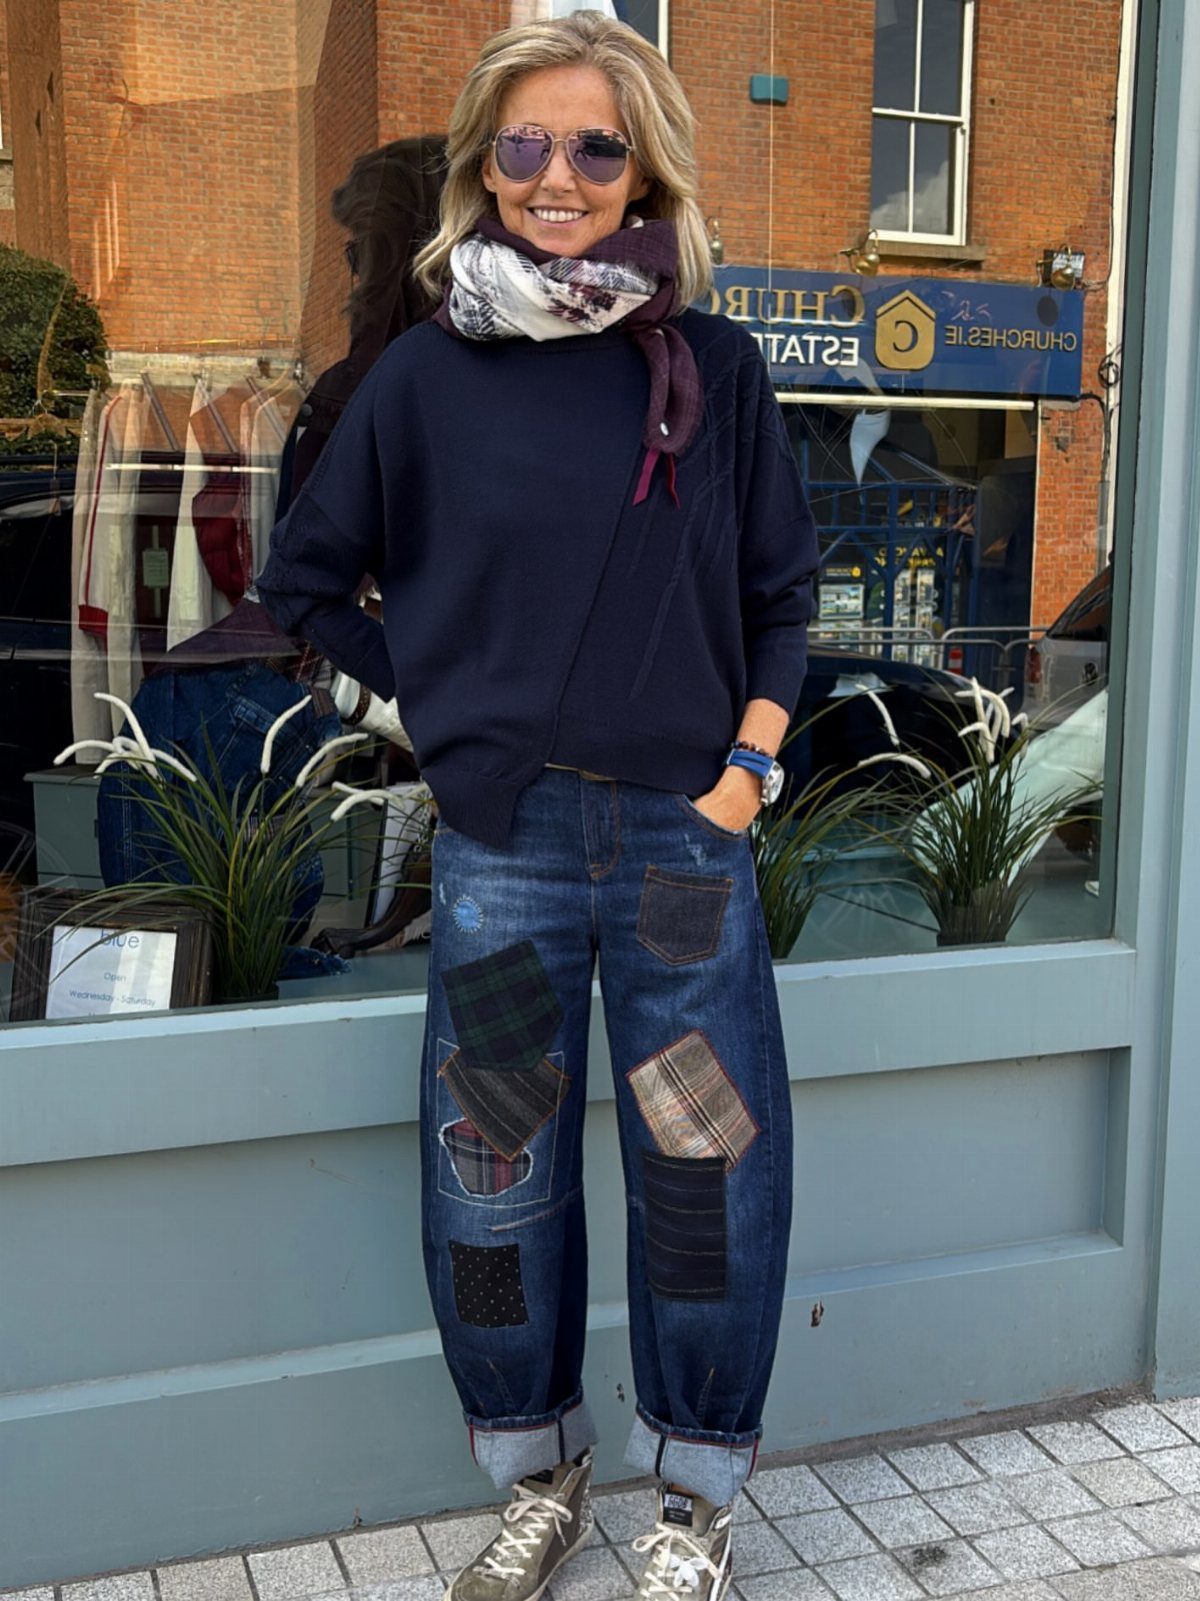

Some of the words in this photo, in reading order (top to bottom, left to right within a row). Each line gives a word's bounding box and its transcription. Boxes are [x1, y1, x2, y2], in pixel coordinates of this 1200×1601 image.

[103, 971, 127, 983] Open
[68, 989, 114, 1002] Wednesday
[121, 995, 157, 1009] Saturday
